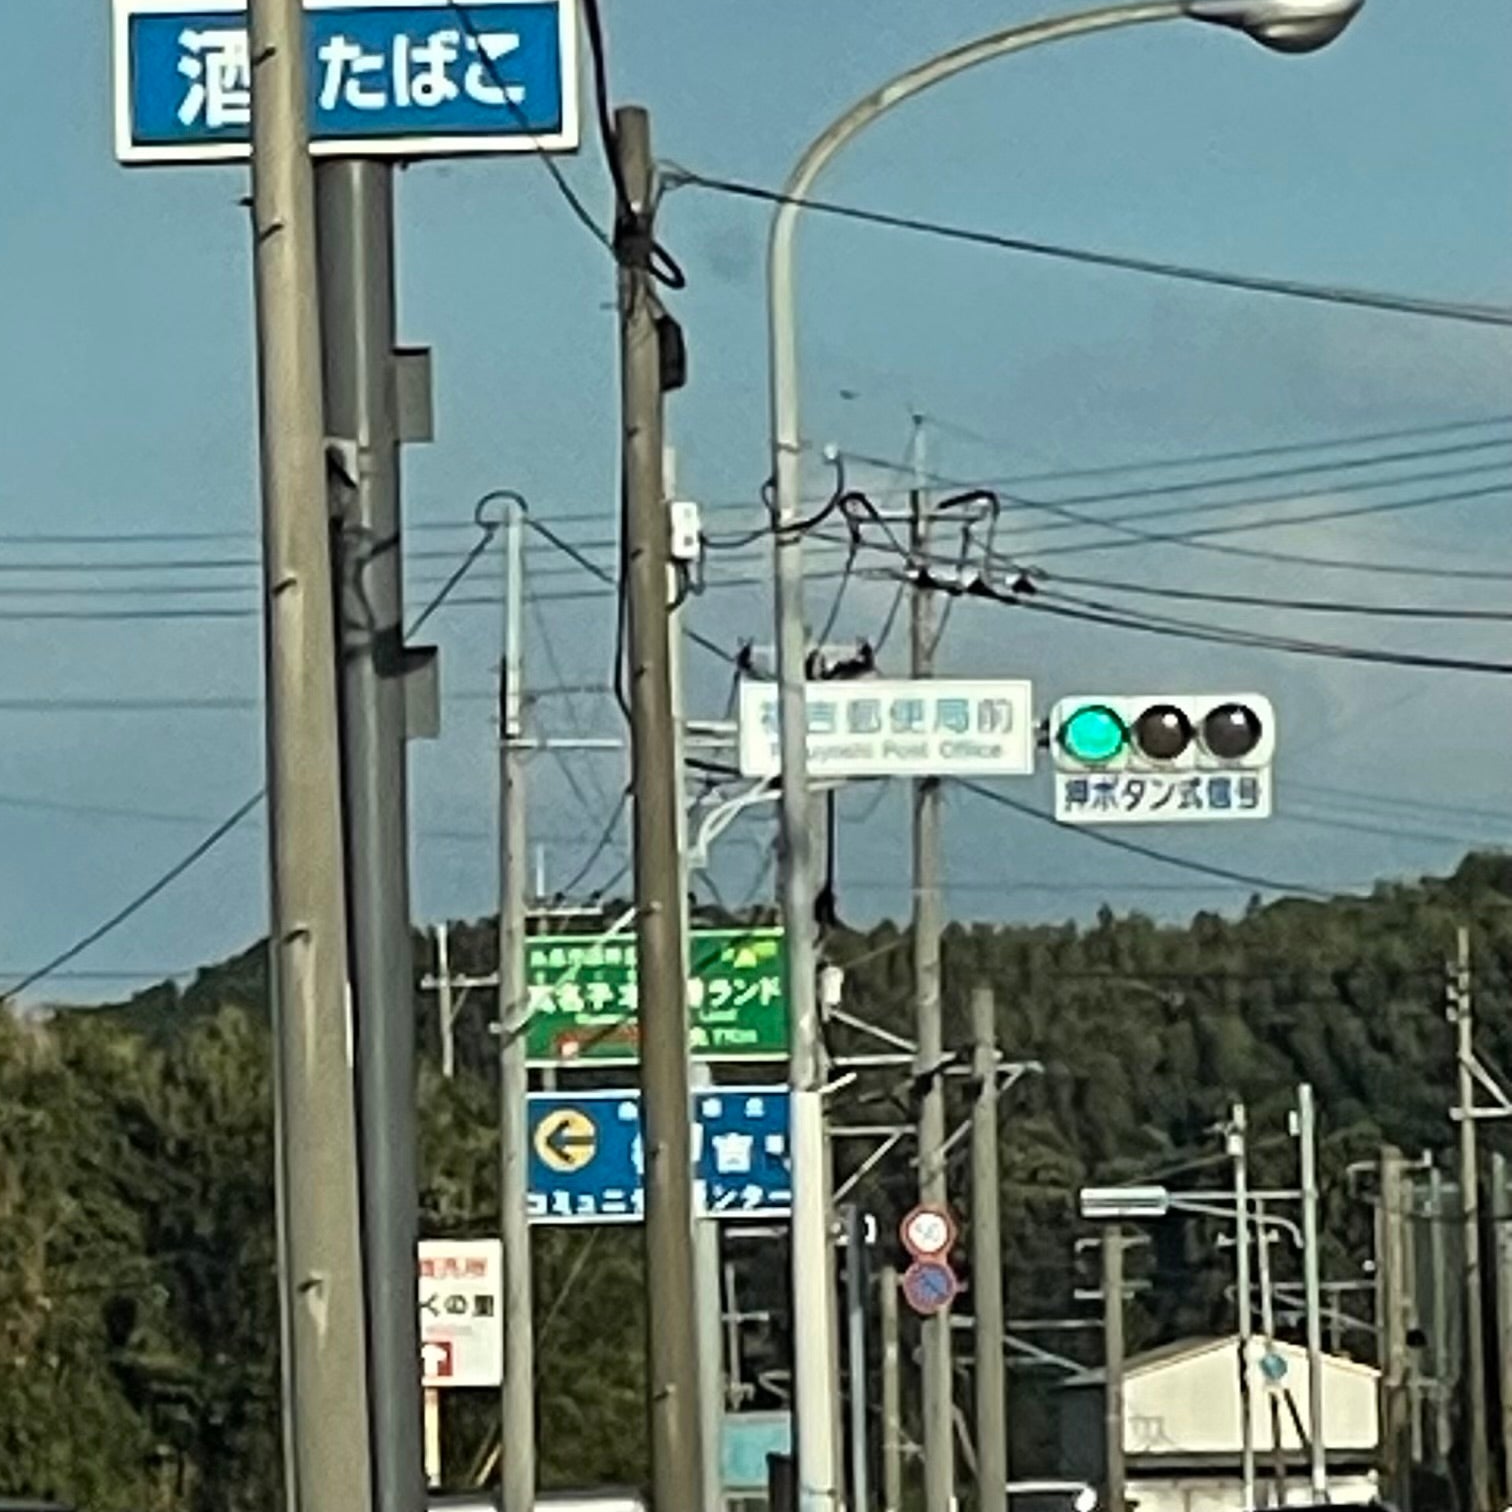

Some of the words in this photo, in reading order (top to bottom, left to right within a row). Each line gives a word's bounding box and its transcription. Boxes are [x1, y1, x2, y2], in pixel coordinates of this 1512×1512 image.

[177, 29, 251, 128] 酒
[318, 29, 525, 110] たばこ
